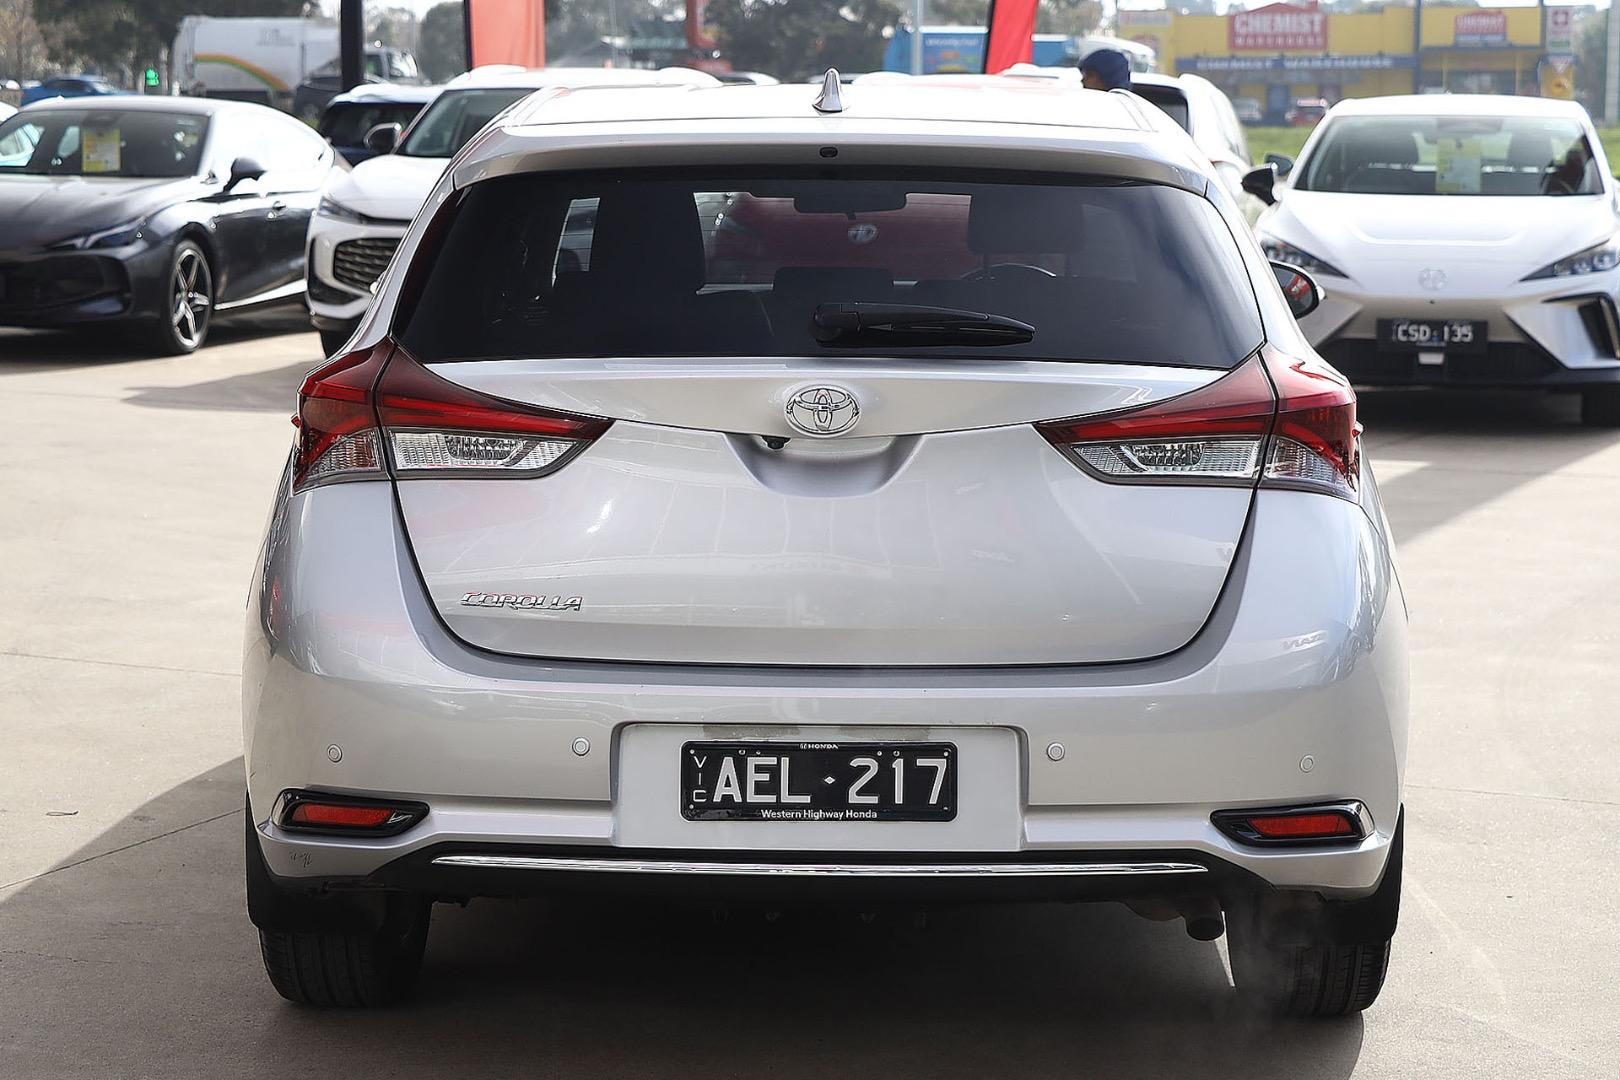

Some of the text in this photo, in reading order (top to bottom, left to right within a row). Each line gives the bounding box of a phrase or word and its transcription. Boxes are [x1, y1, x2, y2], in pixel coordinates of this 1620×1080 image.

[1234, 13, 1322, 34] CHEMIST
[1397, 324, 1431, 342] CSD
[1443, 324, 1474, 342] 135
[461, 592, 583, 611] COROLLA
[693, 756, 707, 803] VIC
[712, 756, 948, 804] AEL 217
[761, 809, 878, 820] Western Highway Honda
